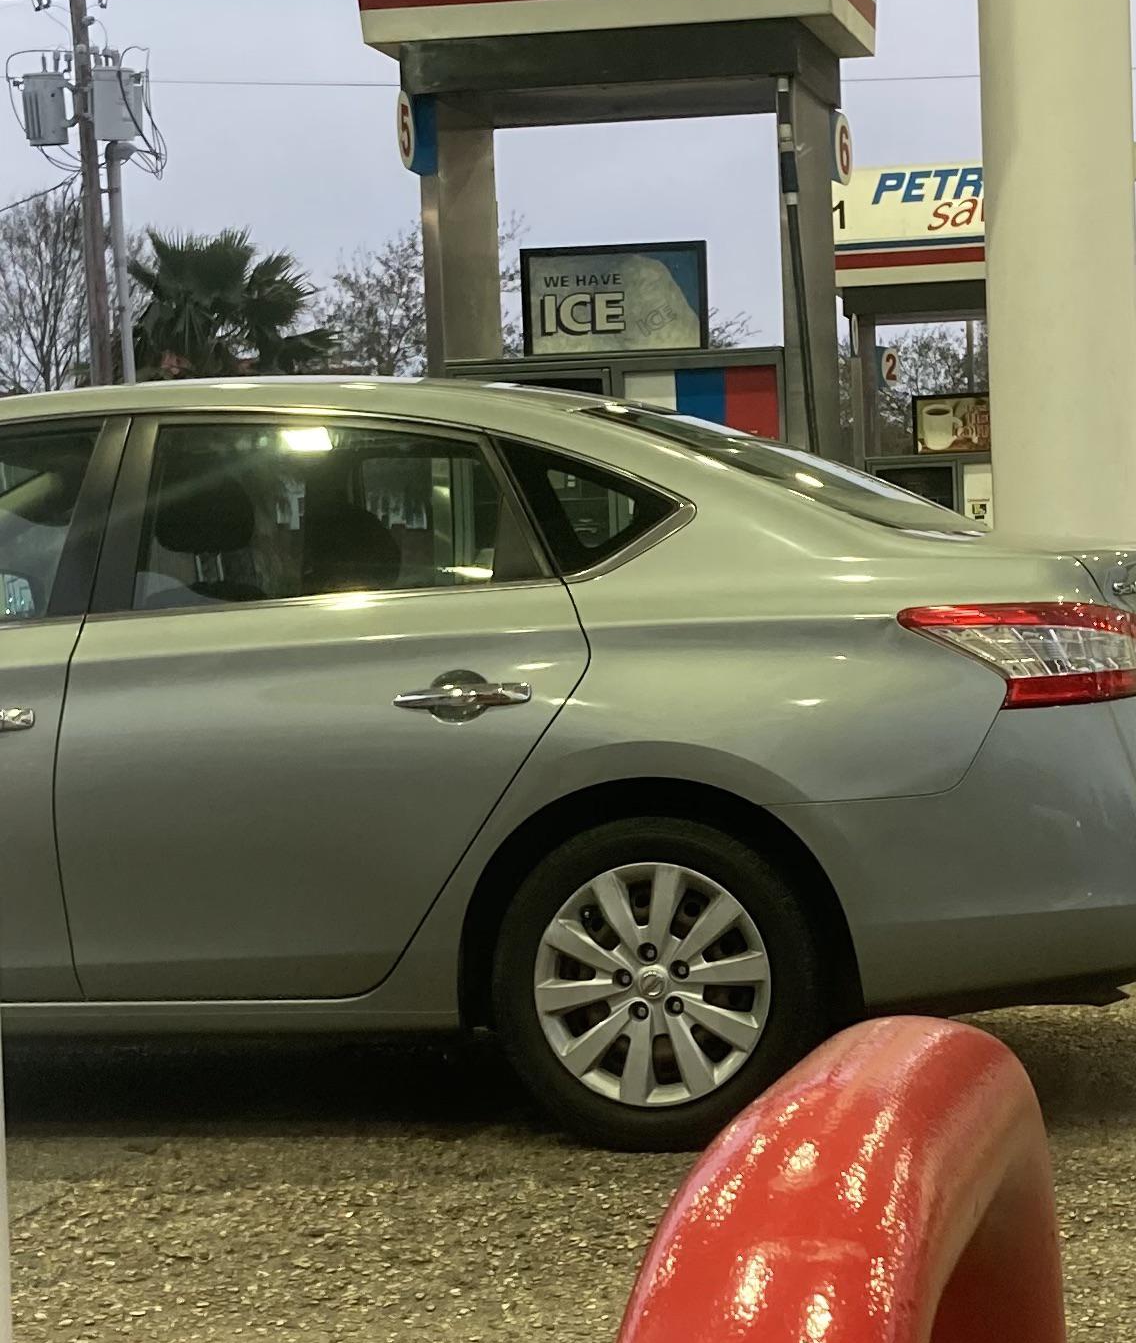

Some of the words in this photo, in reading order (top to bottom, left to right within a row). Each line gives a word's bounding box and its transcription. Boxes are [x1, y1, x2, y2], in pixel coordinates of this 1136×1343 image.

[401, 103, 411, 157] 5
[839, 125, 850, 175] 6
[871, 167, 984, 205] PETR
[927, 198, 985, 231] sa
[544, 275, 570, 288] WE
[576, 273, 622, 287] HAVE
[540, 291, 626, 337] ICE
[636, 303, 678, 338] ICE
[885, 353, 897, 381] 2
